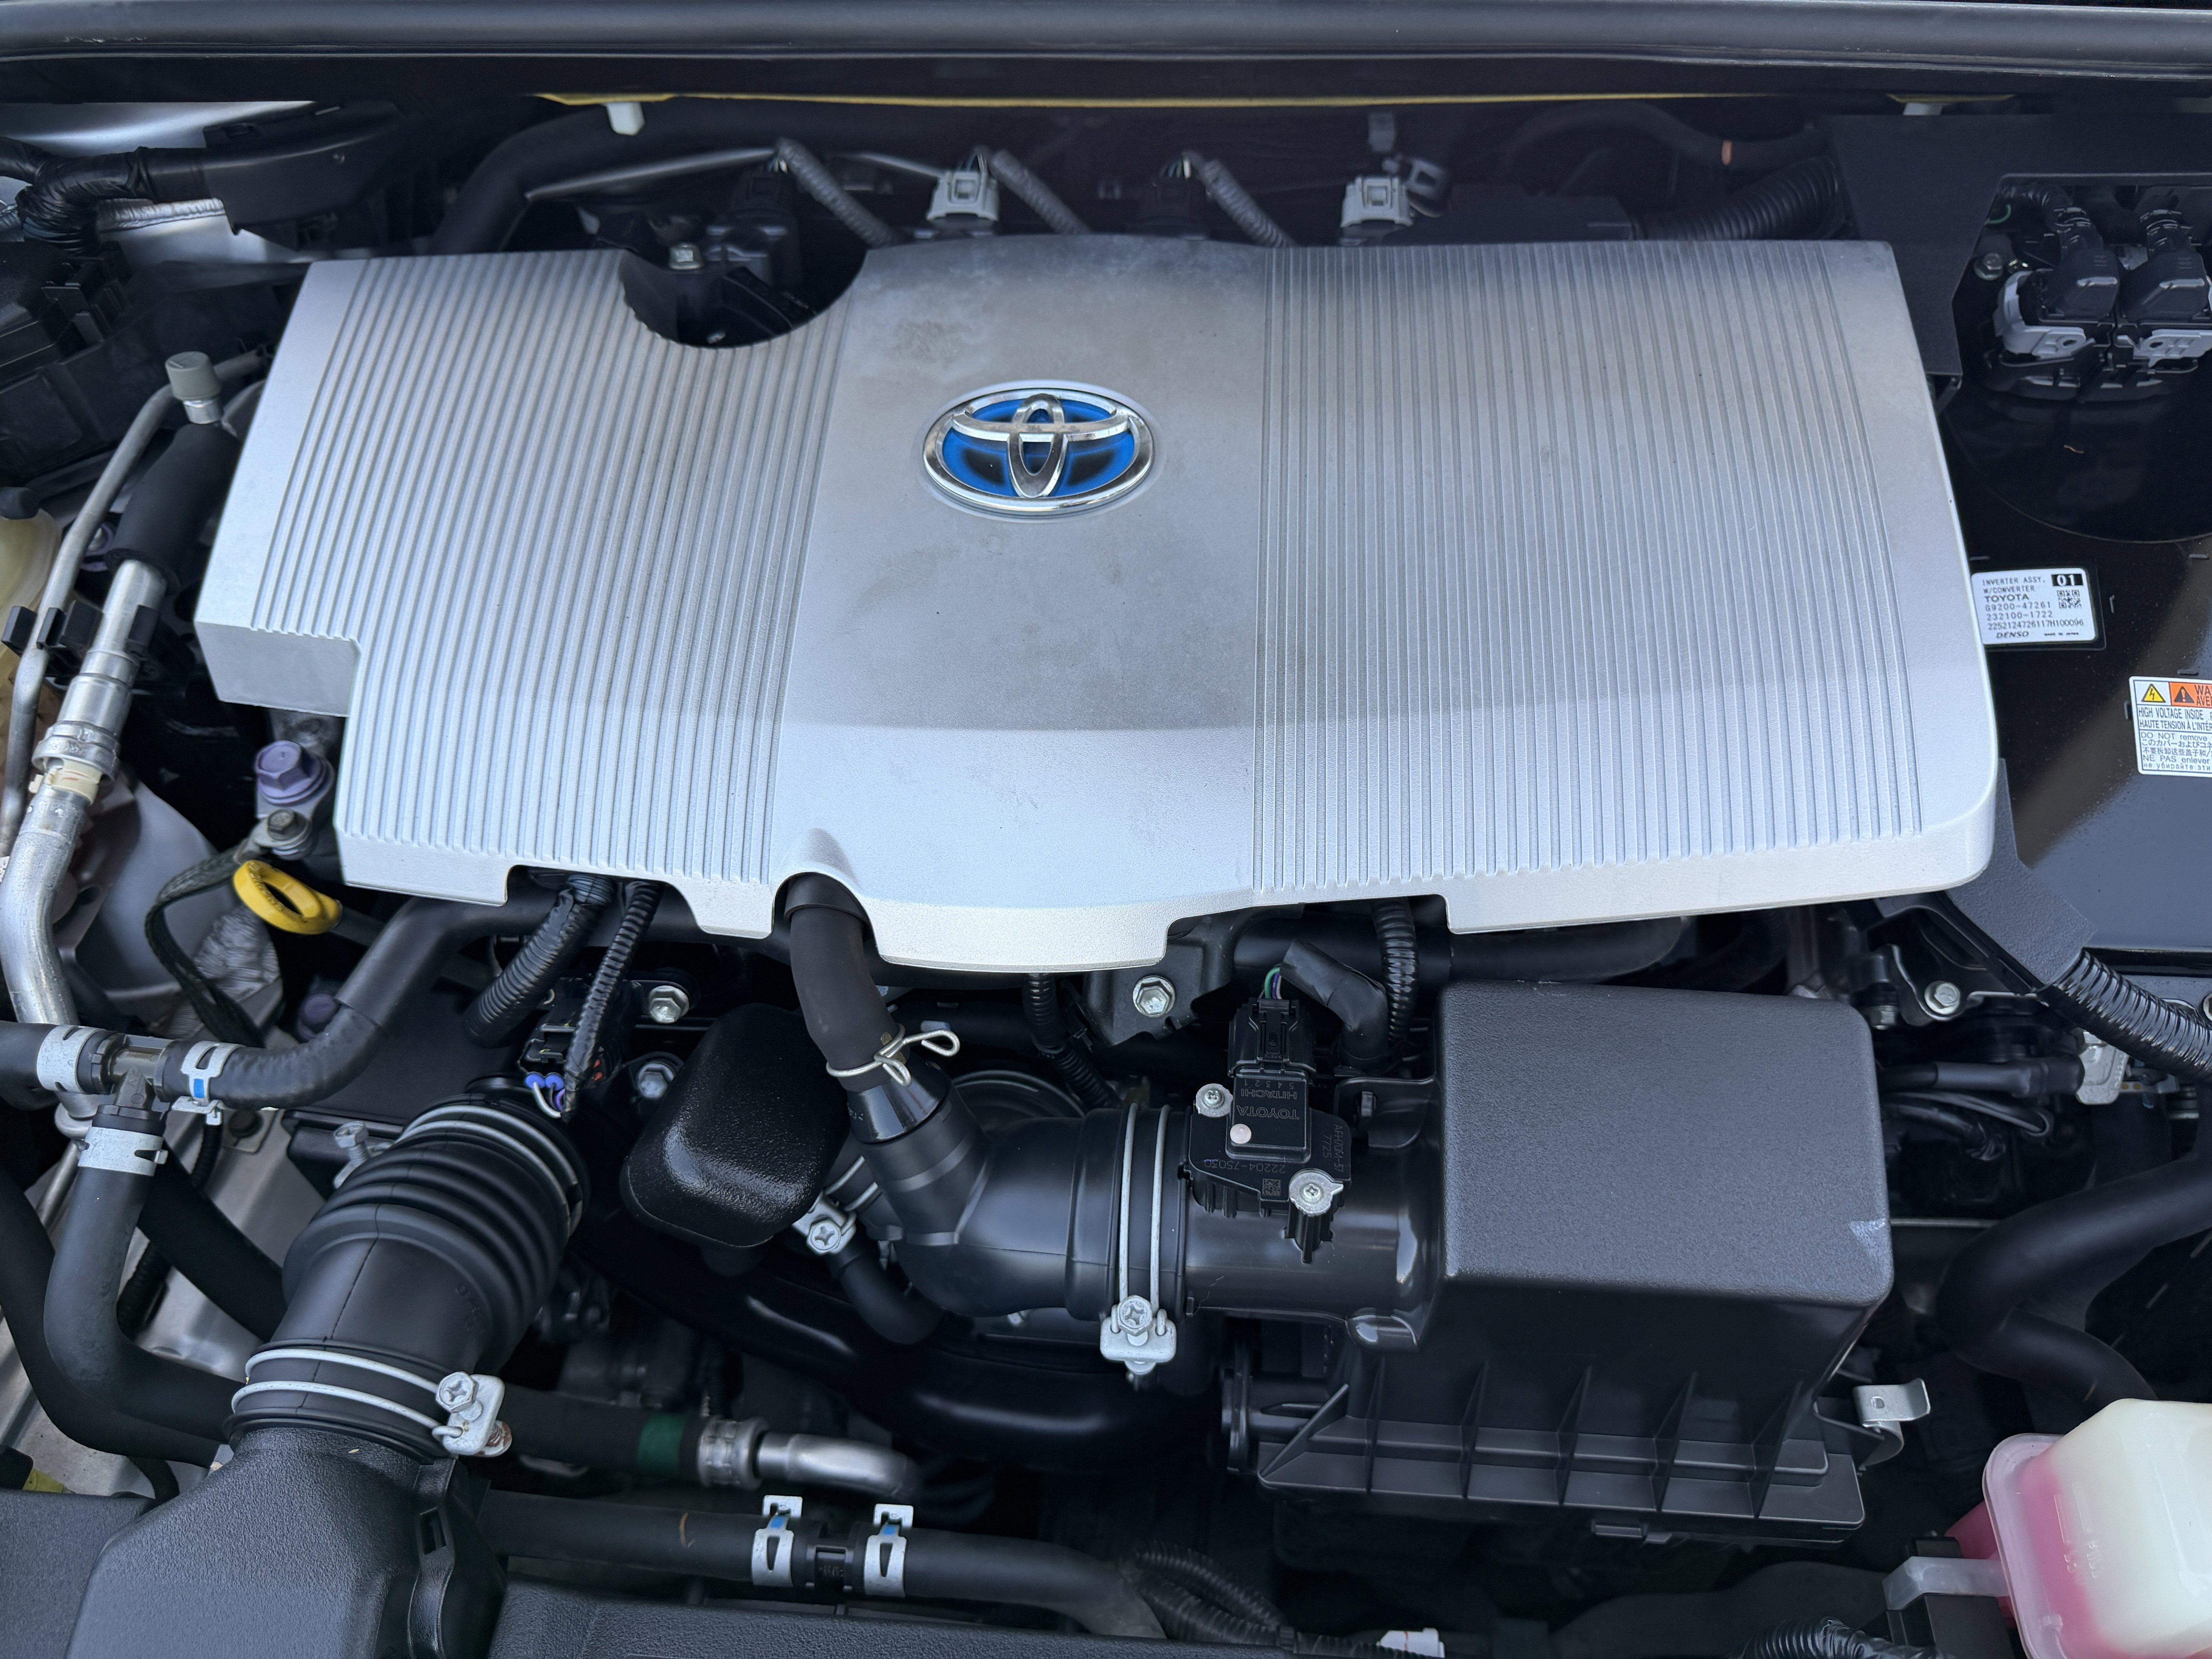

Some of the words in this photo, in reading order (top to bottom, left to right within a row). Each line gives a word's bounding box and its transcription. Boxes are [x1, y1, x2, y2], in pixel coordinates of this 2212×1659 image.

[1982, 577, 2019, 586] INVERTER
[2057, 575, 2075, 586] 01
[1983, 585, 2035, 594] W/CONVERTER
[1984, 593, 2030, 603] TOYOTA
[1986, 610, 2053, 621] 232100-1722
[1996, 630, 2029, 639] DENSO
[2194, 684, 2212, 696] WA
[2197, 696, 2212, 706] AVE
[2138, 707, 2153, 718] HIGH
[2155, 708, 2183, 719] VOLTAGE
[2185, 709, 2204, 720] INSIDE
[2140, 720, 2160, 728] HAUTE
[2160, 720, 2186, 730] TENSION
[2181, 756, 2210, 764] enlever
[1241, 1088, 1297, 1099] HITACHI
[1236, 1105, 1300, 1120] TOYOTA
[1322, 1134, 1331, 1158] 7725
[1204, 1159, 1285, 1173] 22204-75030
